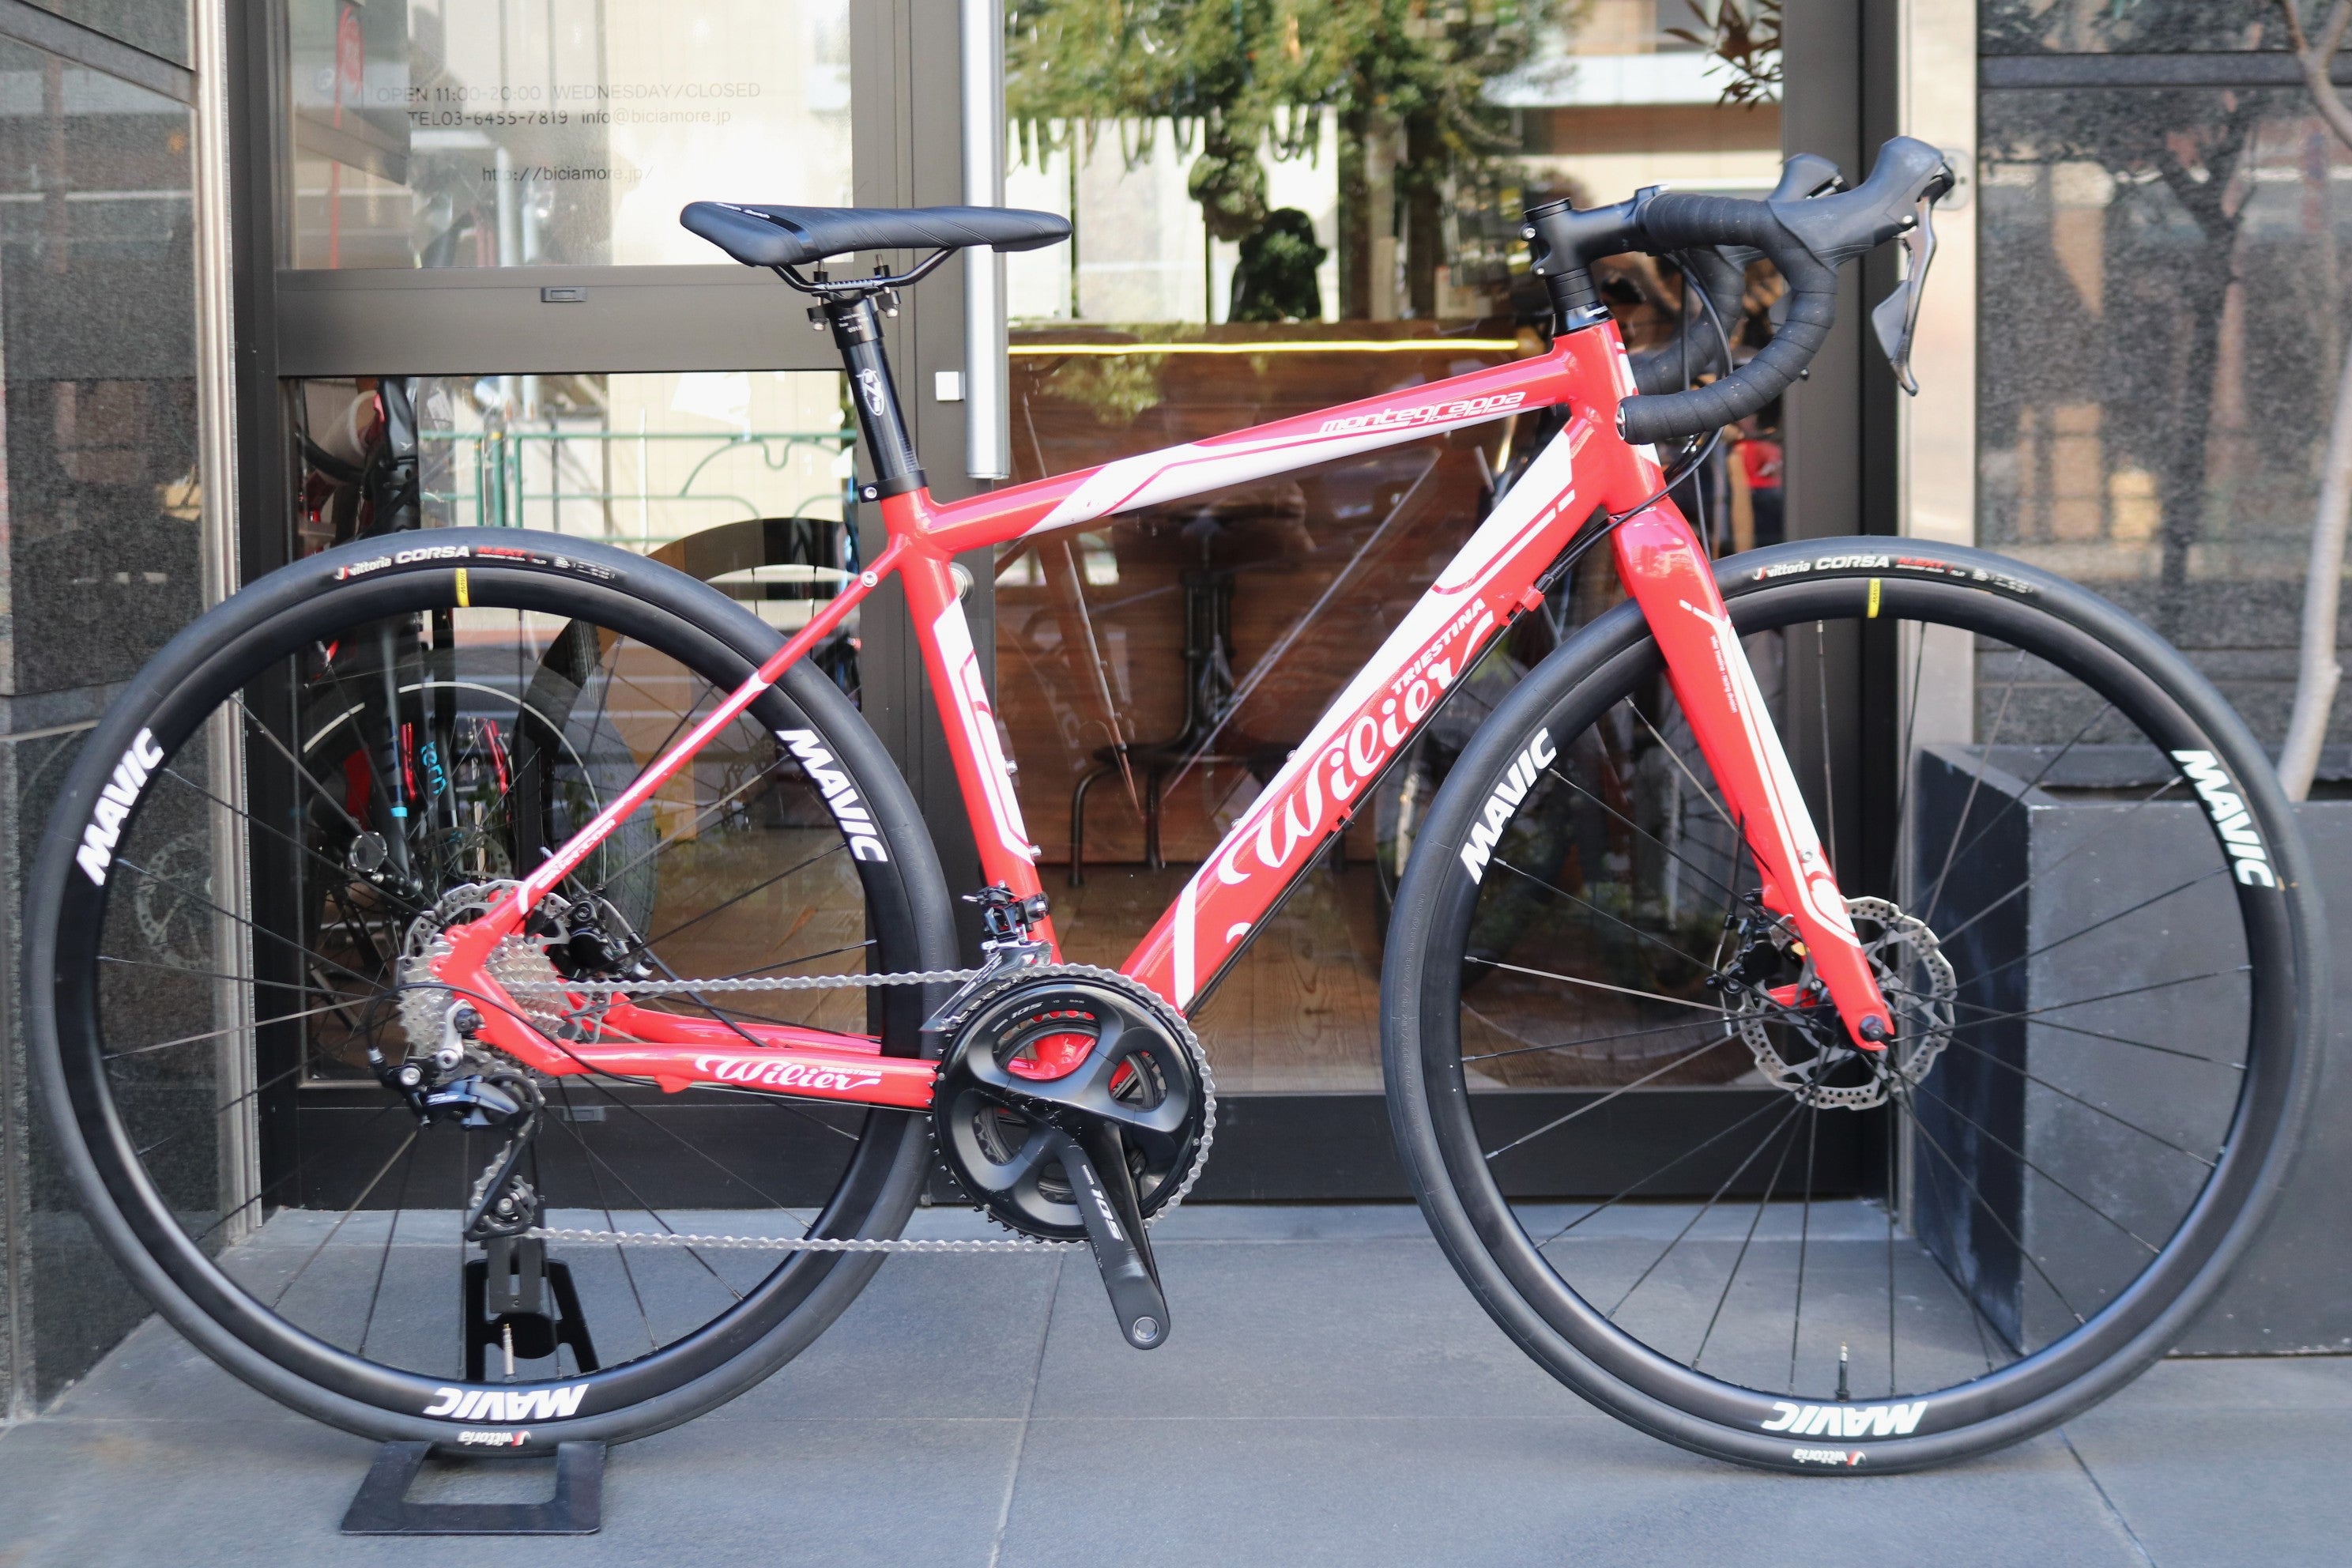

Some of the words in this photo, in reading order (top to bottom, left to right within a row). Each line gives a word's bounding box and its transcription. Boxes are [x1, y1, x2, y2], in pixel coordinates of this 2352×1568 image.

[376, 88, 428, 103] OPEN
[435, 85, 541, 102] 11:00-20:00
[552, 82, 762, 100] WEDNESDAY/CLOSED
[408, 110, 569, 126] TEL03-6455-7819
[581, 108, 732, 126] info@biciamore.jp
[481, 166, 654, 184] htp://biciamore.jp/
[1318, 390, 1526, 434] montegrappa
[349, 556, 392, 577] vittoria
[395, 545, 471, 565] CORSA
[1766, 560, 1811, 579] vittoria
[1815, 555, 1890, 571] CORSA
[1391, 597, 1487, 696] TRIESTINA
[1217, 609, 1494, 885] Wilier
[76, 726, 165, 887] MAVIC
[774, 729, 889, 862] MAVIC
[1460, 726, 1558, 886] MAVIC
[2169, 749, 2276, 888] MAVIC
[1010, 1001, 1044, 1020] 105
[694, 1054, 881, 1091] Wilier
[1091, 1188, 1125, 1242] 105
[423, 1383, 590, 1421] MAVIC
[1761, 1401, 1928, 1437] MAVIC
[457, 1430, 514, 1446] vittoria
[1792, 1448, 1849, 1465] vittoria
